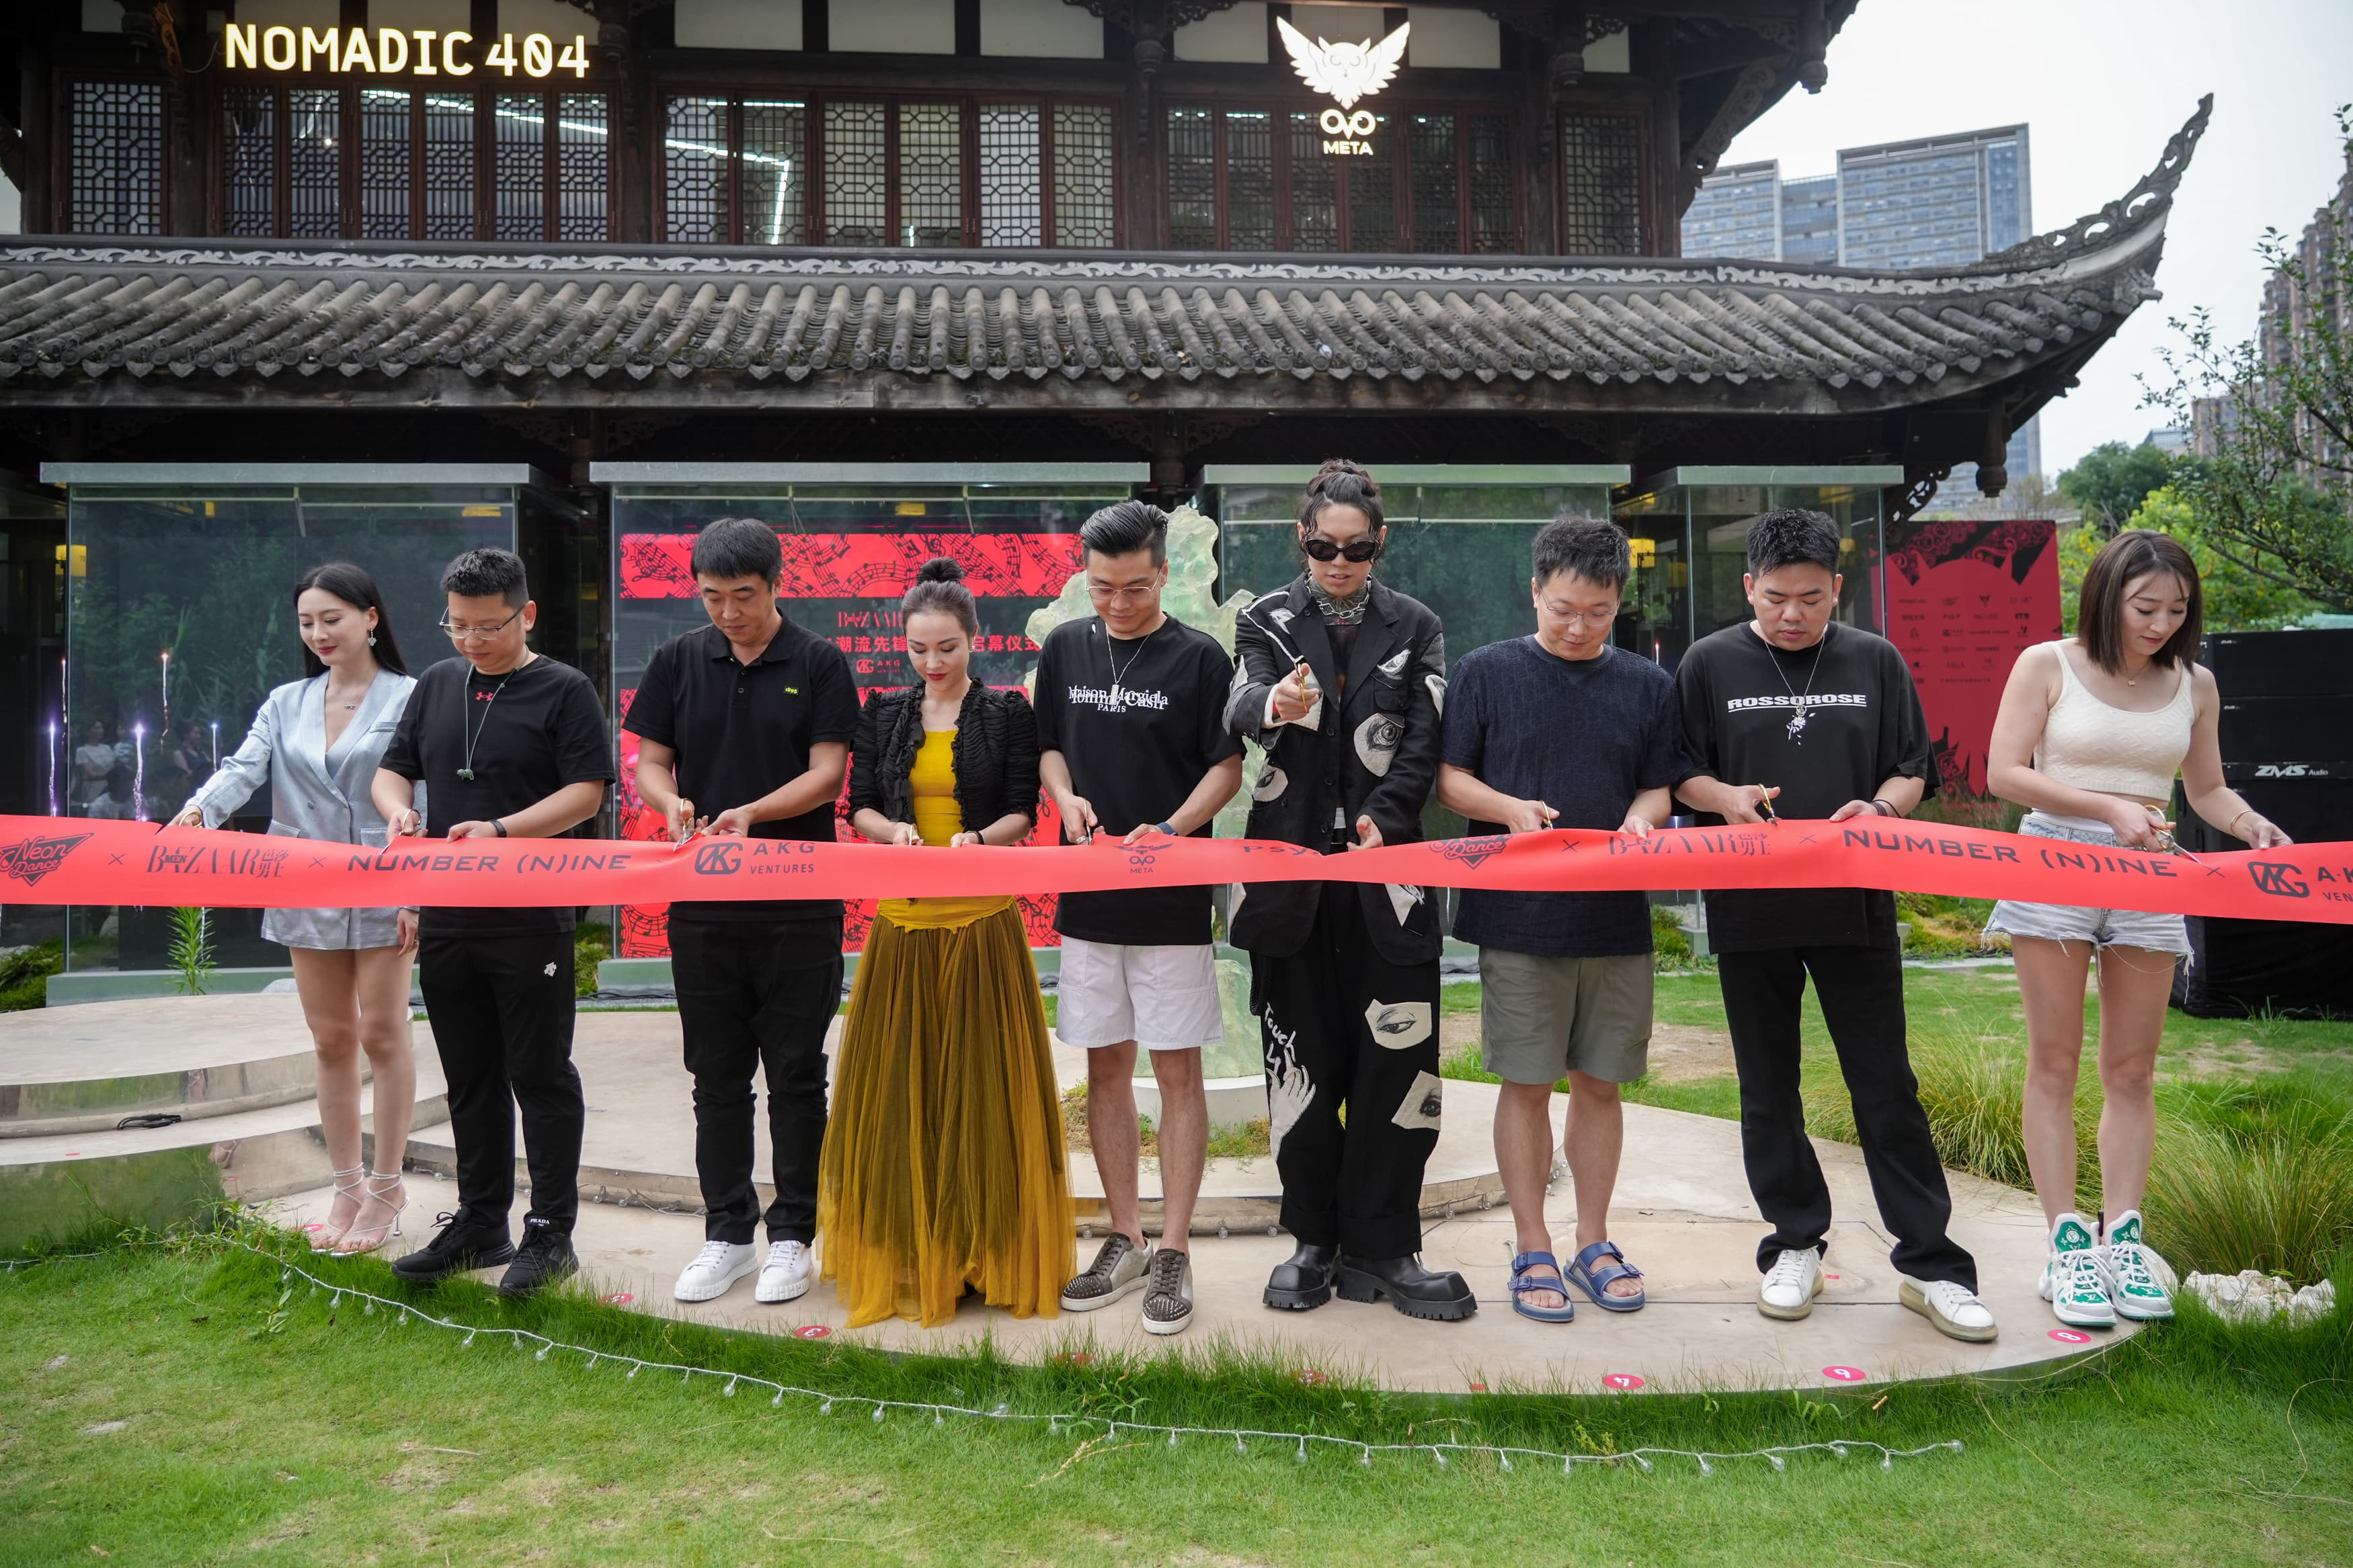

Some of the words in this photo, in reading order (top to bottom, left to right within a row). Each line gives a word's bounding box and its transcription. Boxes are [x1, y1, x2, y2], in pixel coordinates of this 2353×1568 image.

[226, 24, 473, 75] NOMADIC
[485, 34, 589, 78] 404
[1323, 140, 1373, 155] META
[1097, 703, 1126, 713] PARIS
[1727, 694, 1867, 710] ROSSOROSE
[0, 835, 68, 872] Neon
[1444, 840, 1507, 860] Dance
[1844, 829, 2022, 864] NUMBER
[2040, 848, 2178, 878] (N)INE
[9, 860, 62, 878] Dance
[348, 854, 500, 872] NUMBER
[516, 854, 631, 874] (N)INE
[750, 864, 815, 875] VENTURES
[2323, 892, 2353, 901] VEN
[2057, 1331, 2082, 1341] 8
